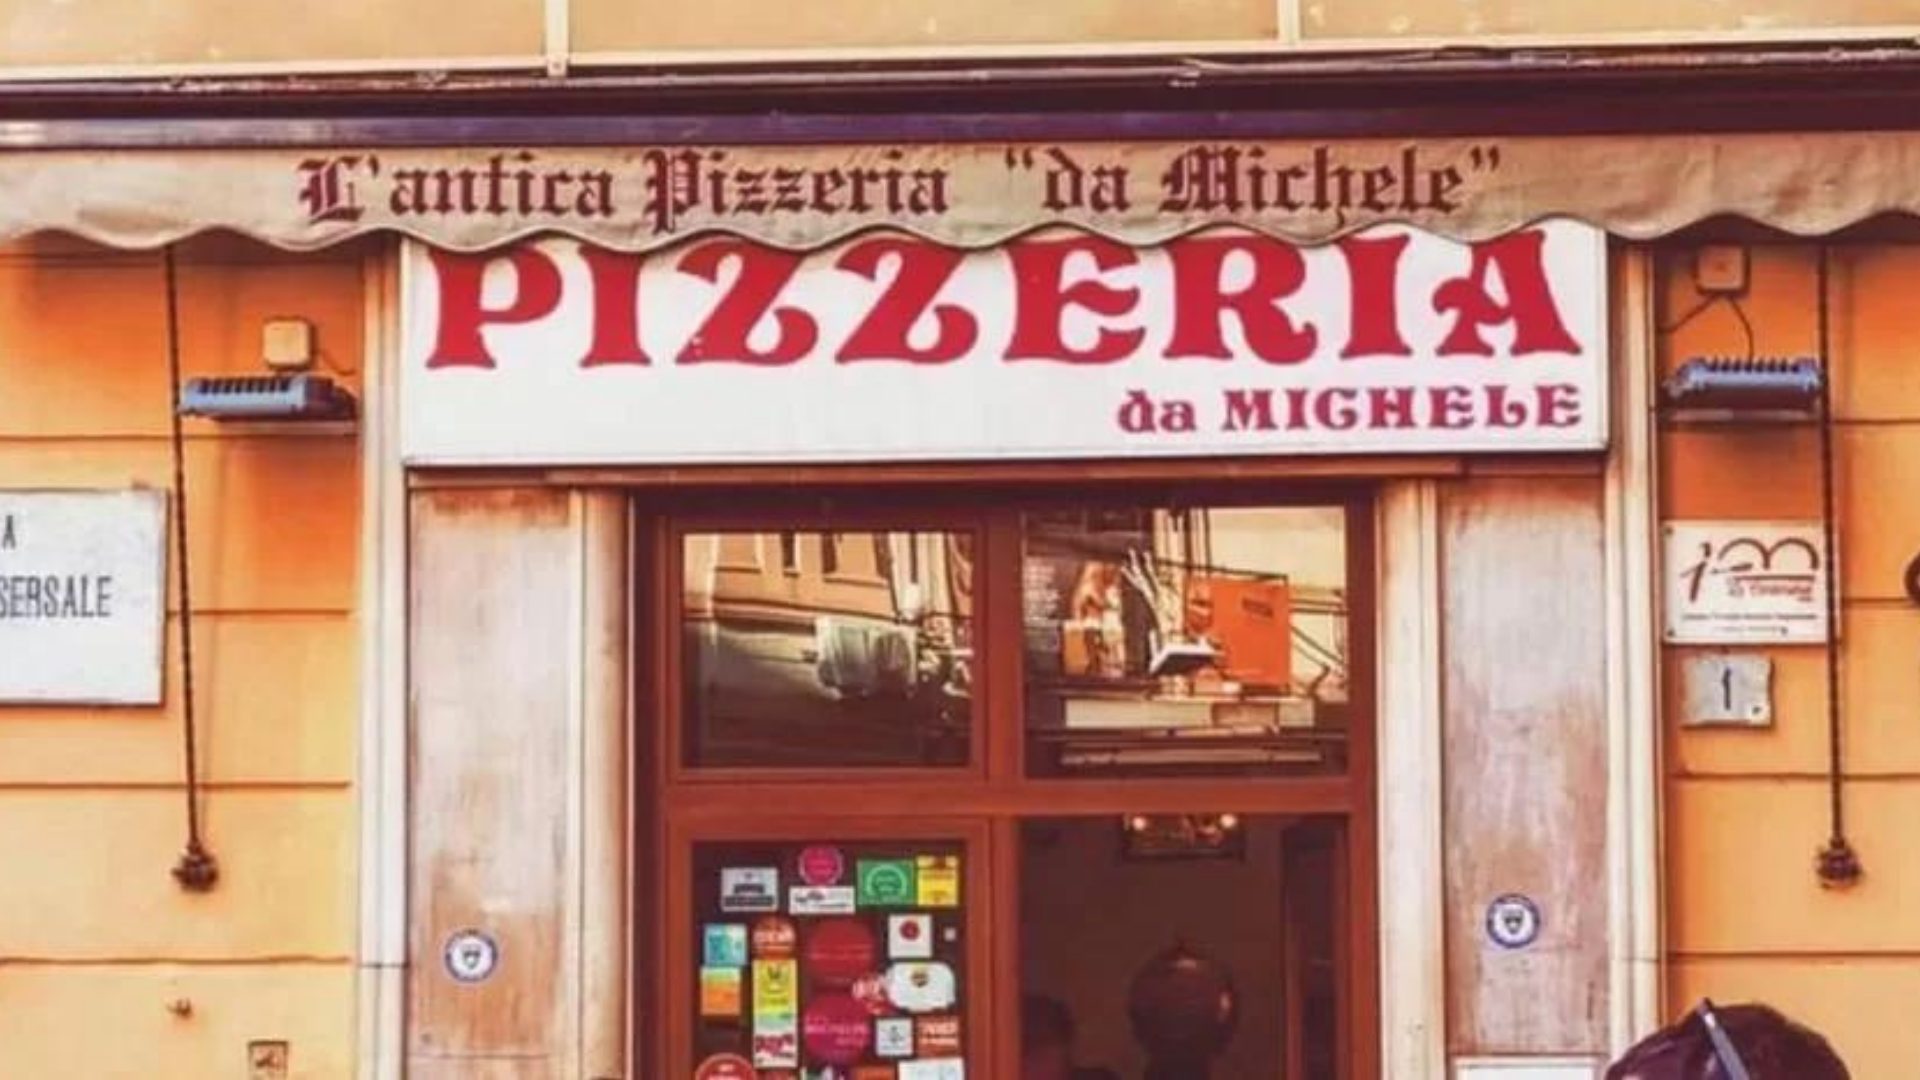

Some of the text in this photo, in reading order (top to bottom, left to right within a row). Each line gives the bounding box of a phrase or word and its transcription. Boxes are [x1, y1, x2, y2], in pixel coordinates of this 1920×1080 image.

[298, 153, 615, 224] L'antica
[643, 149, 949, 233] Pizzeria
[424, 228, 1583, 370] PIZZERIA
[1117, 384, 1582, 434] da MICHELE
[1721, 666, 1733, 711] 1
